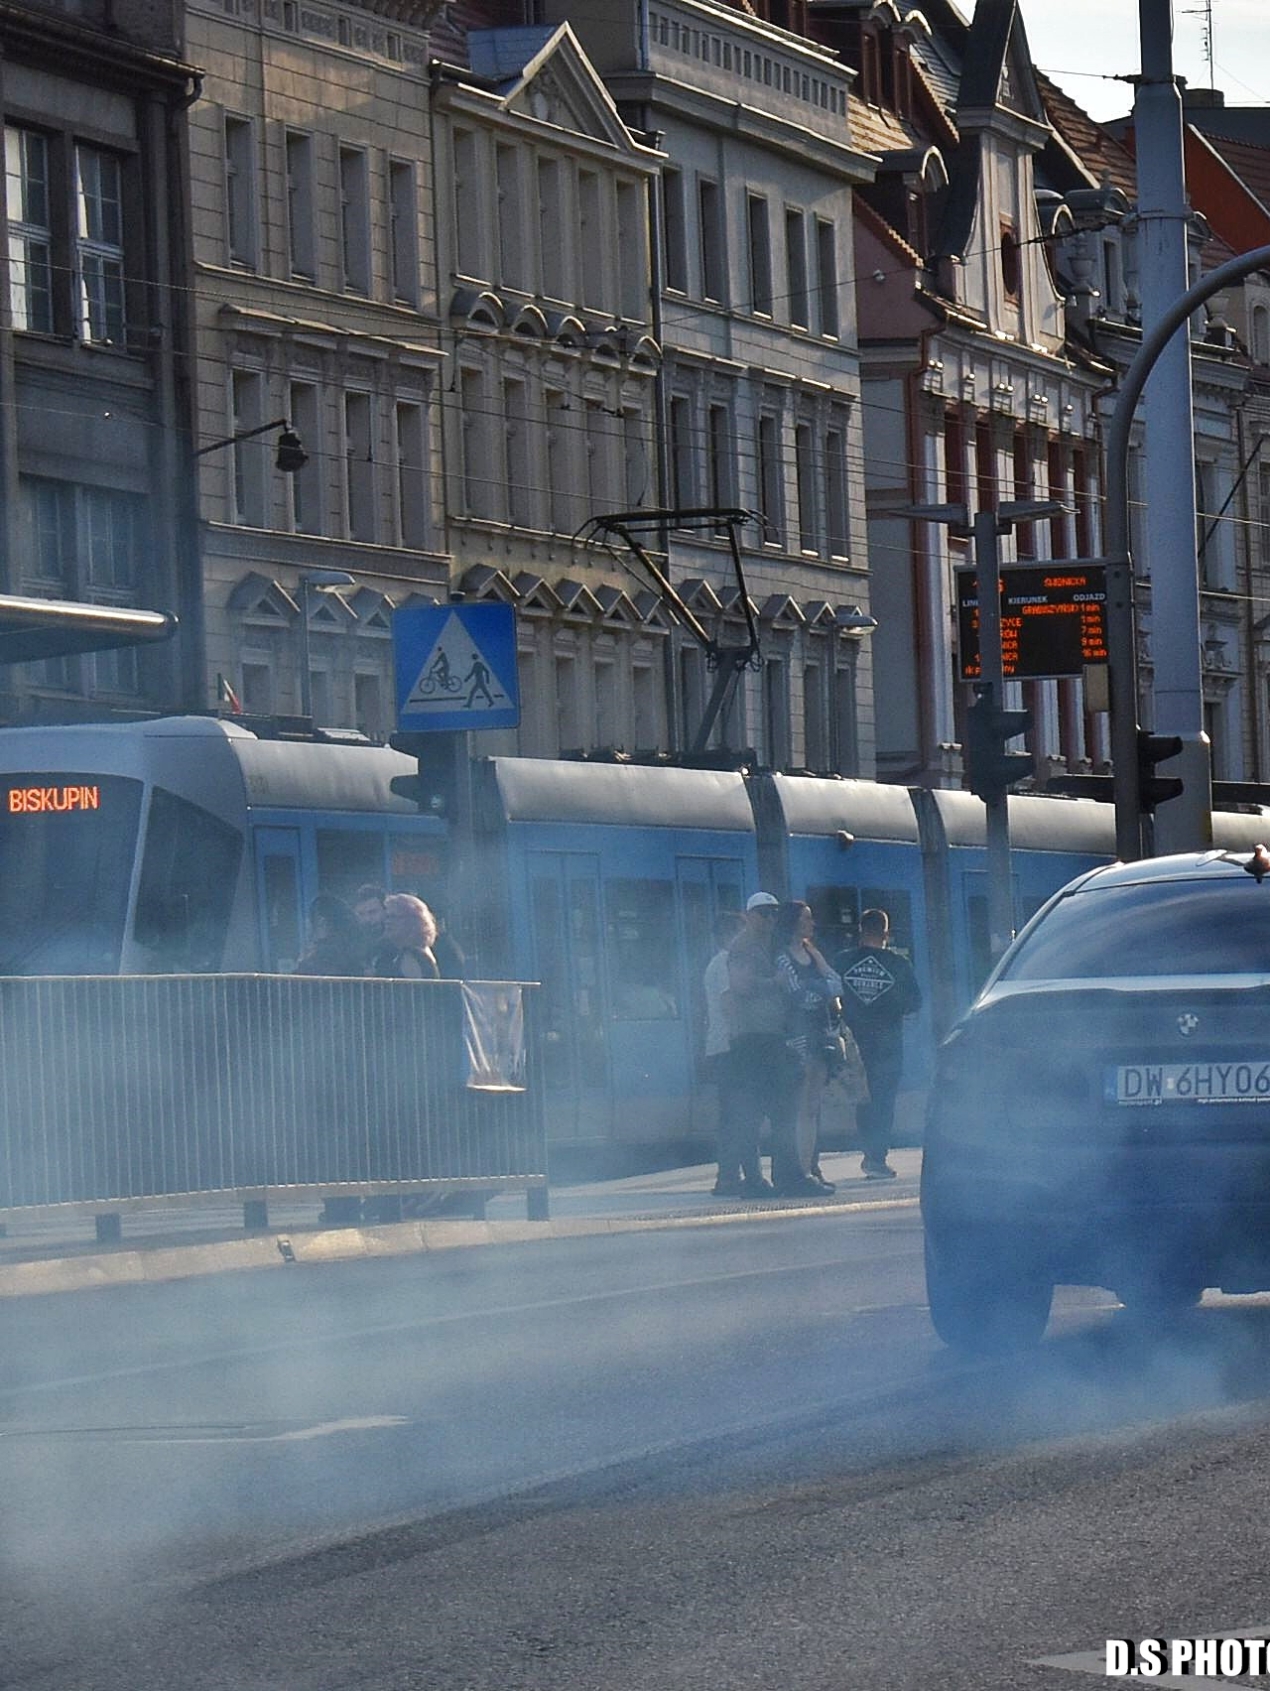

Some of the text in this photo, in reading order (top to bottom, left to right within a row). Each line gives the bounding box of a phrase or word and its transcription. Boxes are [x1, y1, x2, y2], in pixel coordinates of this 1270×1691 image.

[1008, 596, 1048, 604] KIERUNEK
[1073, 593, 1105, 601] ODJAZD
[8, 786, 99, 812] BISKUPIN
[1124, 1064, 1270, 1098] DW 6HY06
